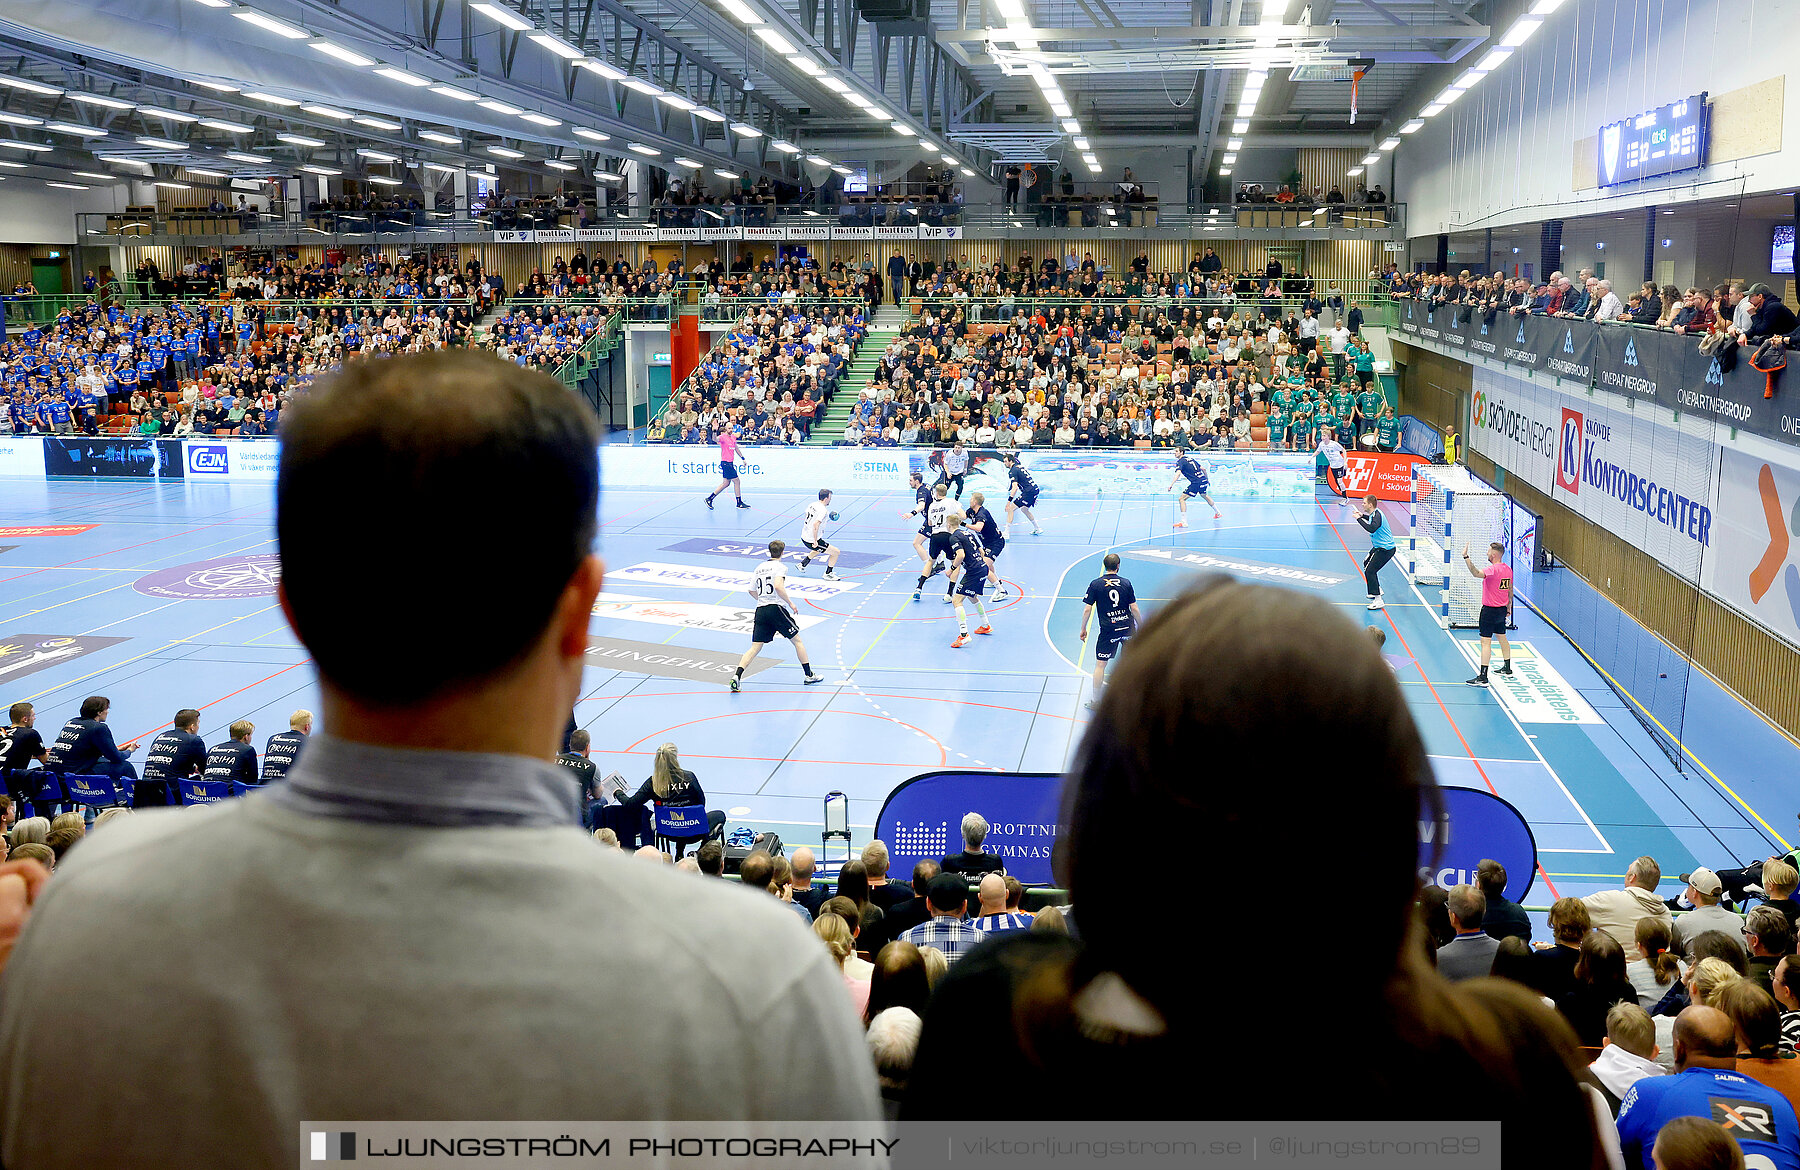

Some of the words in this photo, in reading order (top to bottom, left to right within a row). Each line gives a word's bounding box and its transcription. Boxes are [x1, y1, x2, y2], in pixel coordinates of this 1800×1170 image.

[499, 231, 515, 240] VIP
[924, 228, 942, 237] VIP
[1677, 388, 1752, 422] ONEPARTNERGROUP
[1585, 417, 1611, 442] SKÖVDE
[668, 459, 678, 474] It
[733, 463, 764, 475] ere.
[864, 462, 899, 473] STENA
[1344, 467, 1371, 481] HTH
[1393, 463, 1407, 472] Din
[1174, 552, 1343, 586] Myresjöhus
[756, 575, 775, 596] 95
[1108, 589, 1120, 608] 9
[584, 645, 738, 674] ILLINGEHUS
[660, 819, 700, 828] BORGUNDA
[985, 822, 1057, 837] ROTTNI
[1417, 812, 1450, 845] vi
[1716, 1102, 1773, 1136] XR
